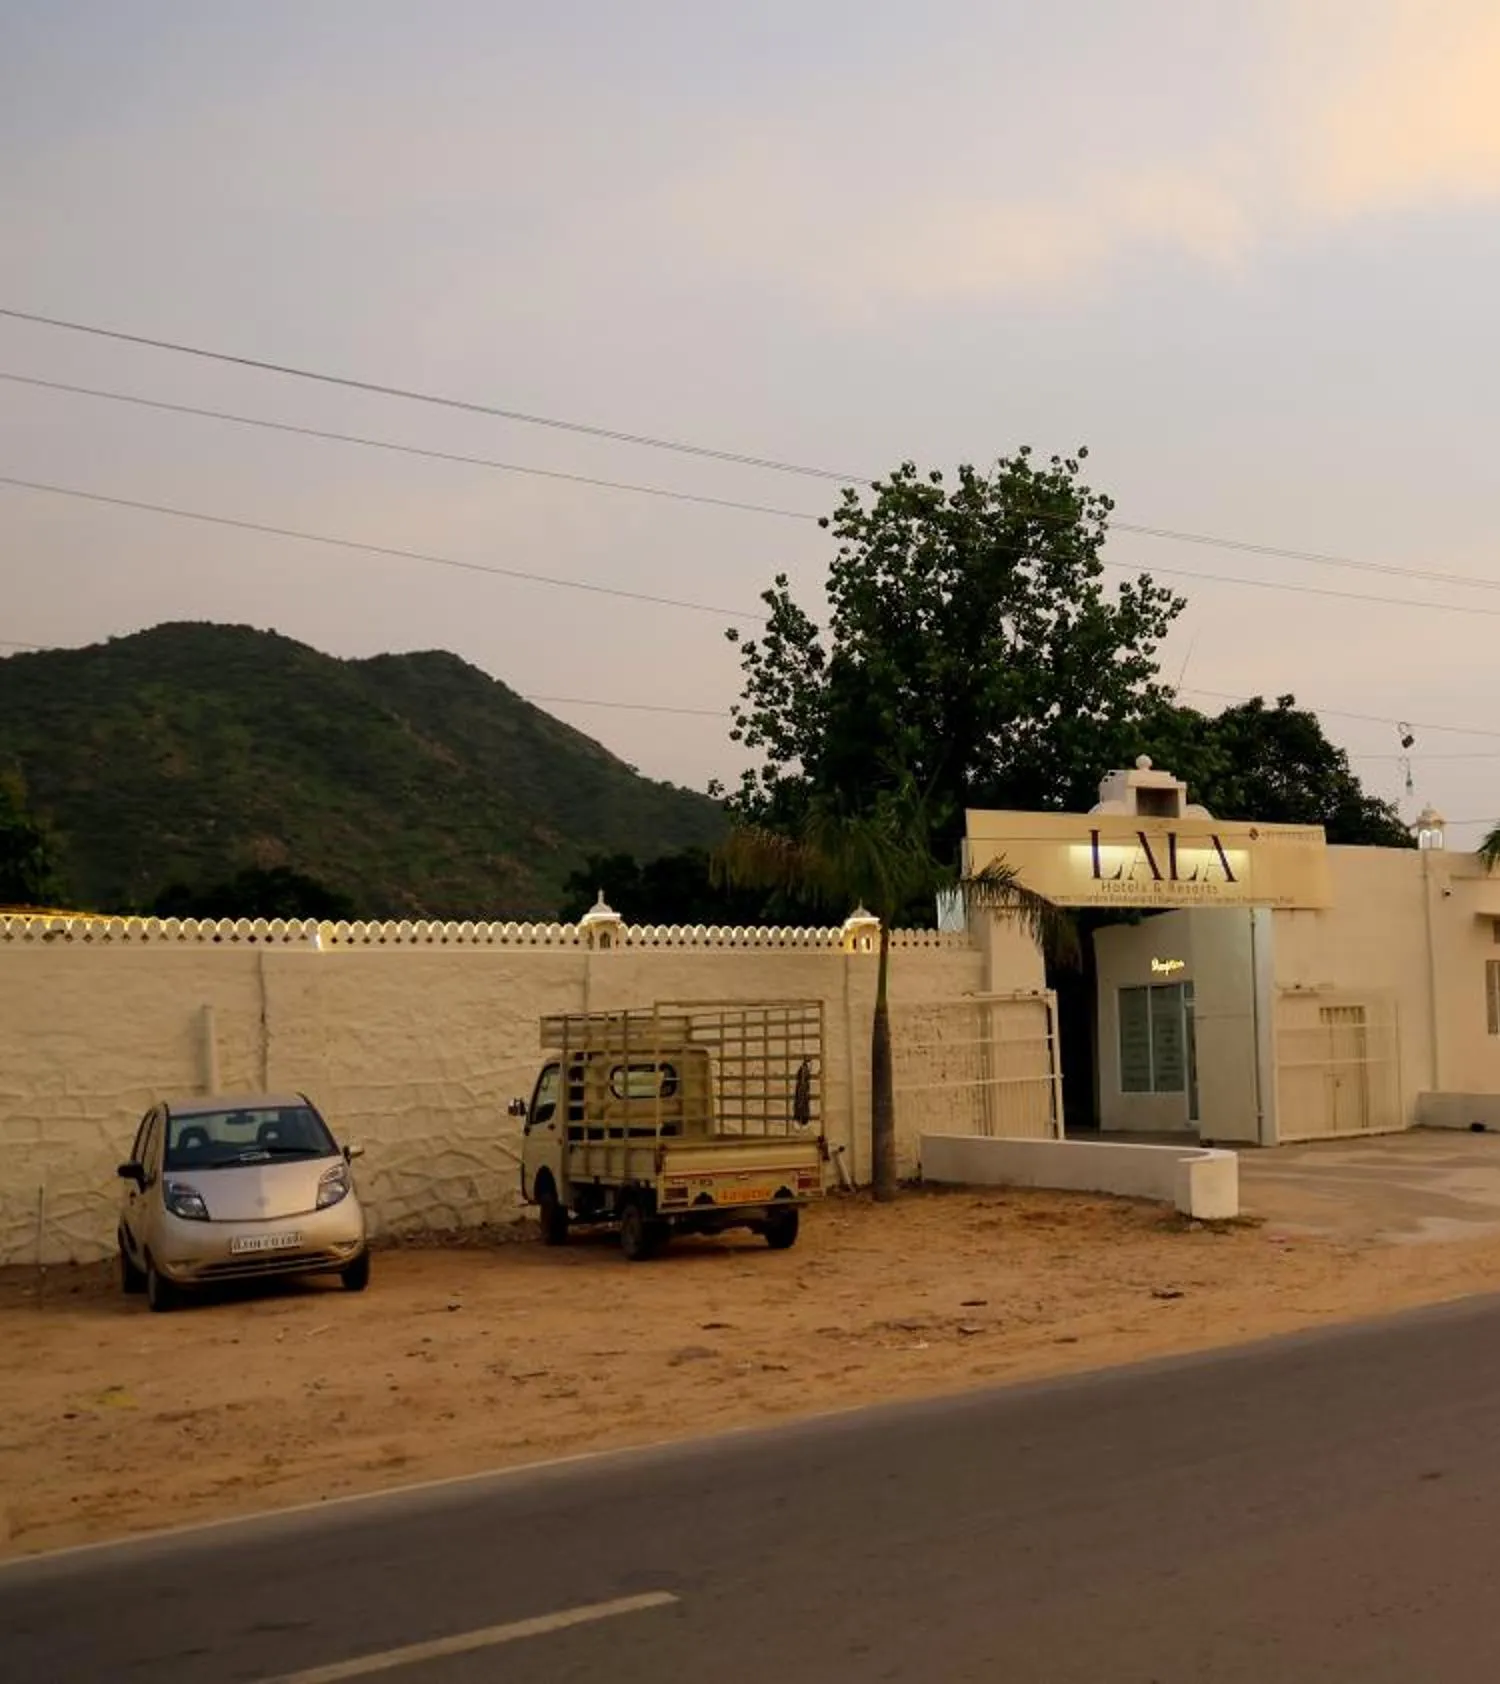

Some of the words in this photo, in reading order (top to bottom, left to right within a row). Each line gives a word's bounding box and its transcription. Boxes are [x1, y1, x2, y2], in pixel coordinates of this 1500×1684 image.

[1089, 829, 1239, 882] LALA
[1101, 881, 1147, 893] Hotels
[1168, 883, 1218, 894] Resorts
